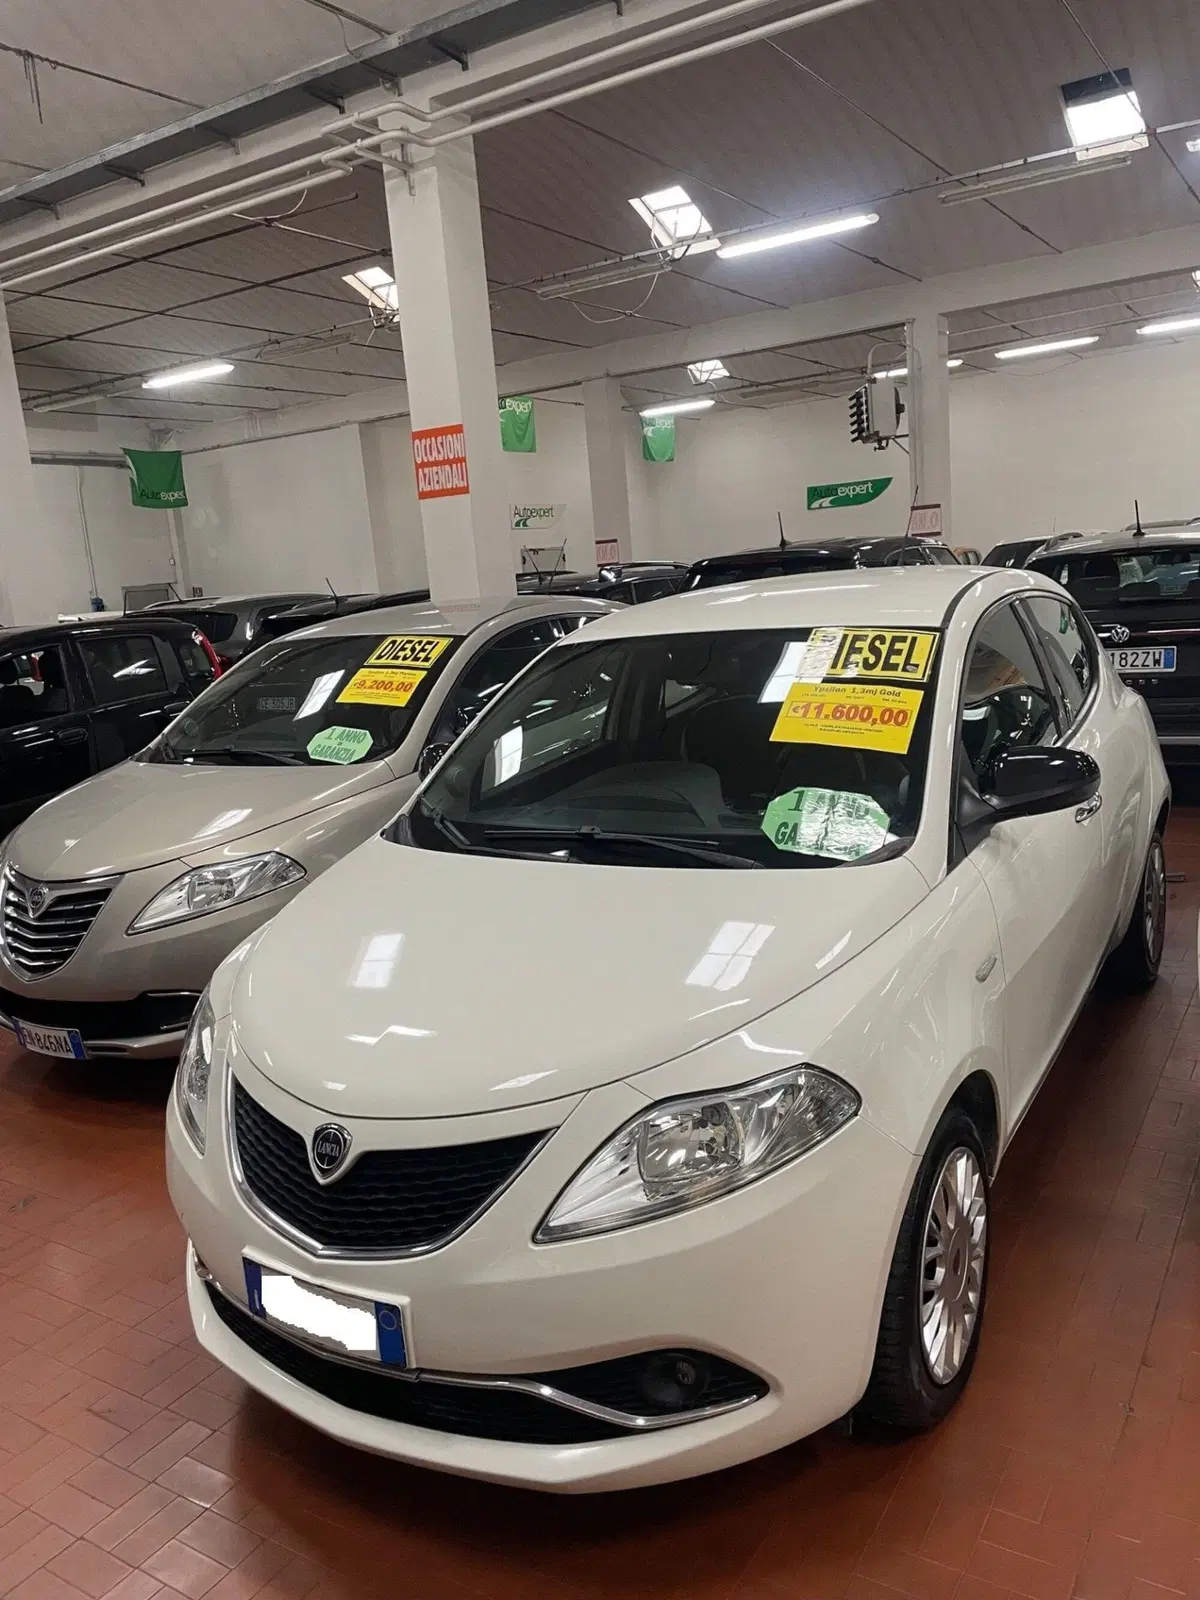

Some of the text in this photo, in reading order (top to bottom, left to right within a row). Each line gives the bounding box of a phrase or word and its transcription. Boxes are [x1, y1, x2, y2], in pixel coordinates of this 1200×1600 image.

[413, 432, 465, 464] OCCASIONI
[418, 462, 468, 492] AZIENDALI
[811, 481, 873, 498] Autoexpert
[513, 505, 554, 519] Autoexpert
[374, 639, 440, 663] DIESEL
[823, 633, 920, 674] IESEL
[813, 685, 846, 694] Ypsilon
[879, 688, 901, 698] Gold
[792, 702, 909, 727] €11.600,00
[324, 728, 367, 744] 1 ANNO
[311, 744, 356, 761] GARANZIA
[787, 790, 805, 812] 1
